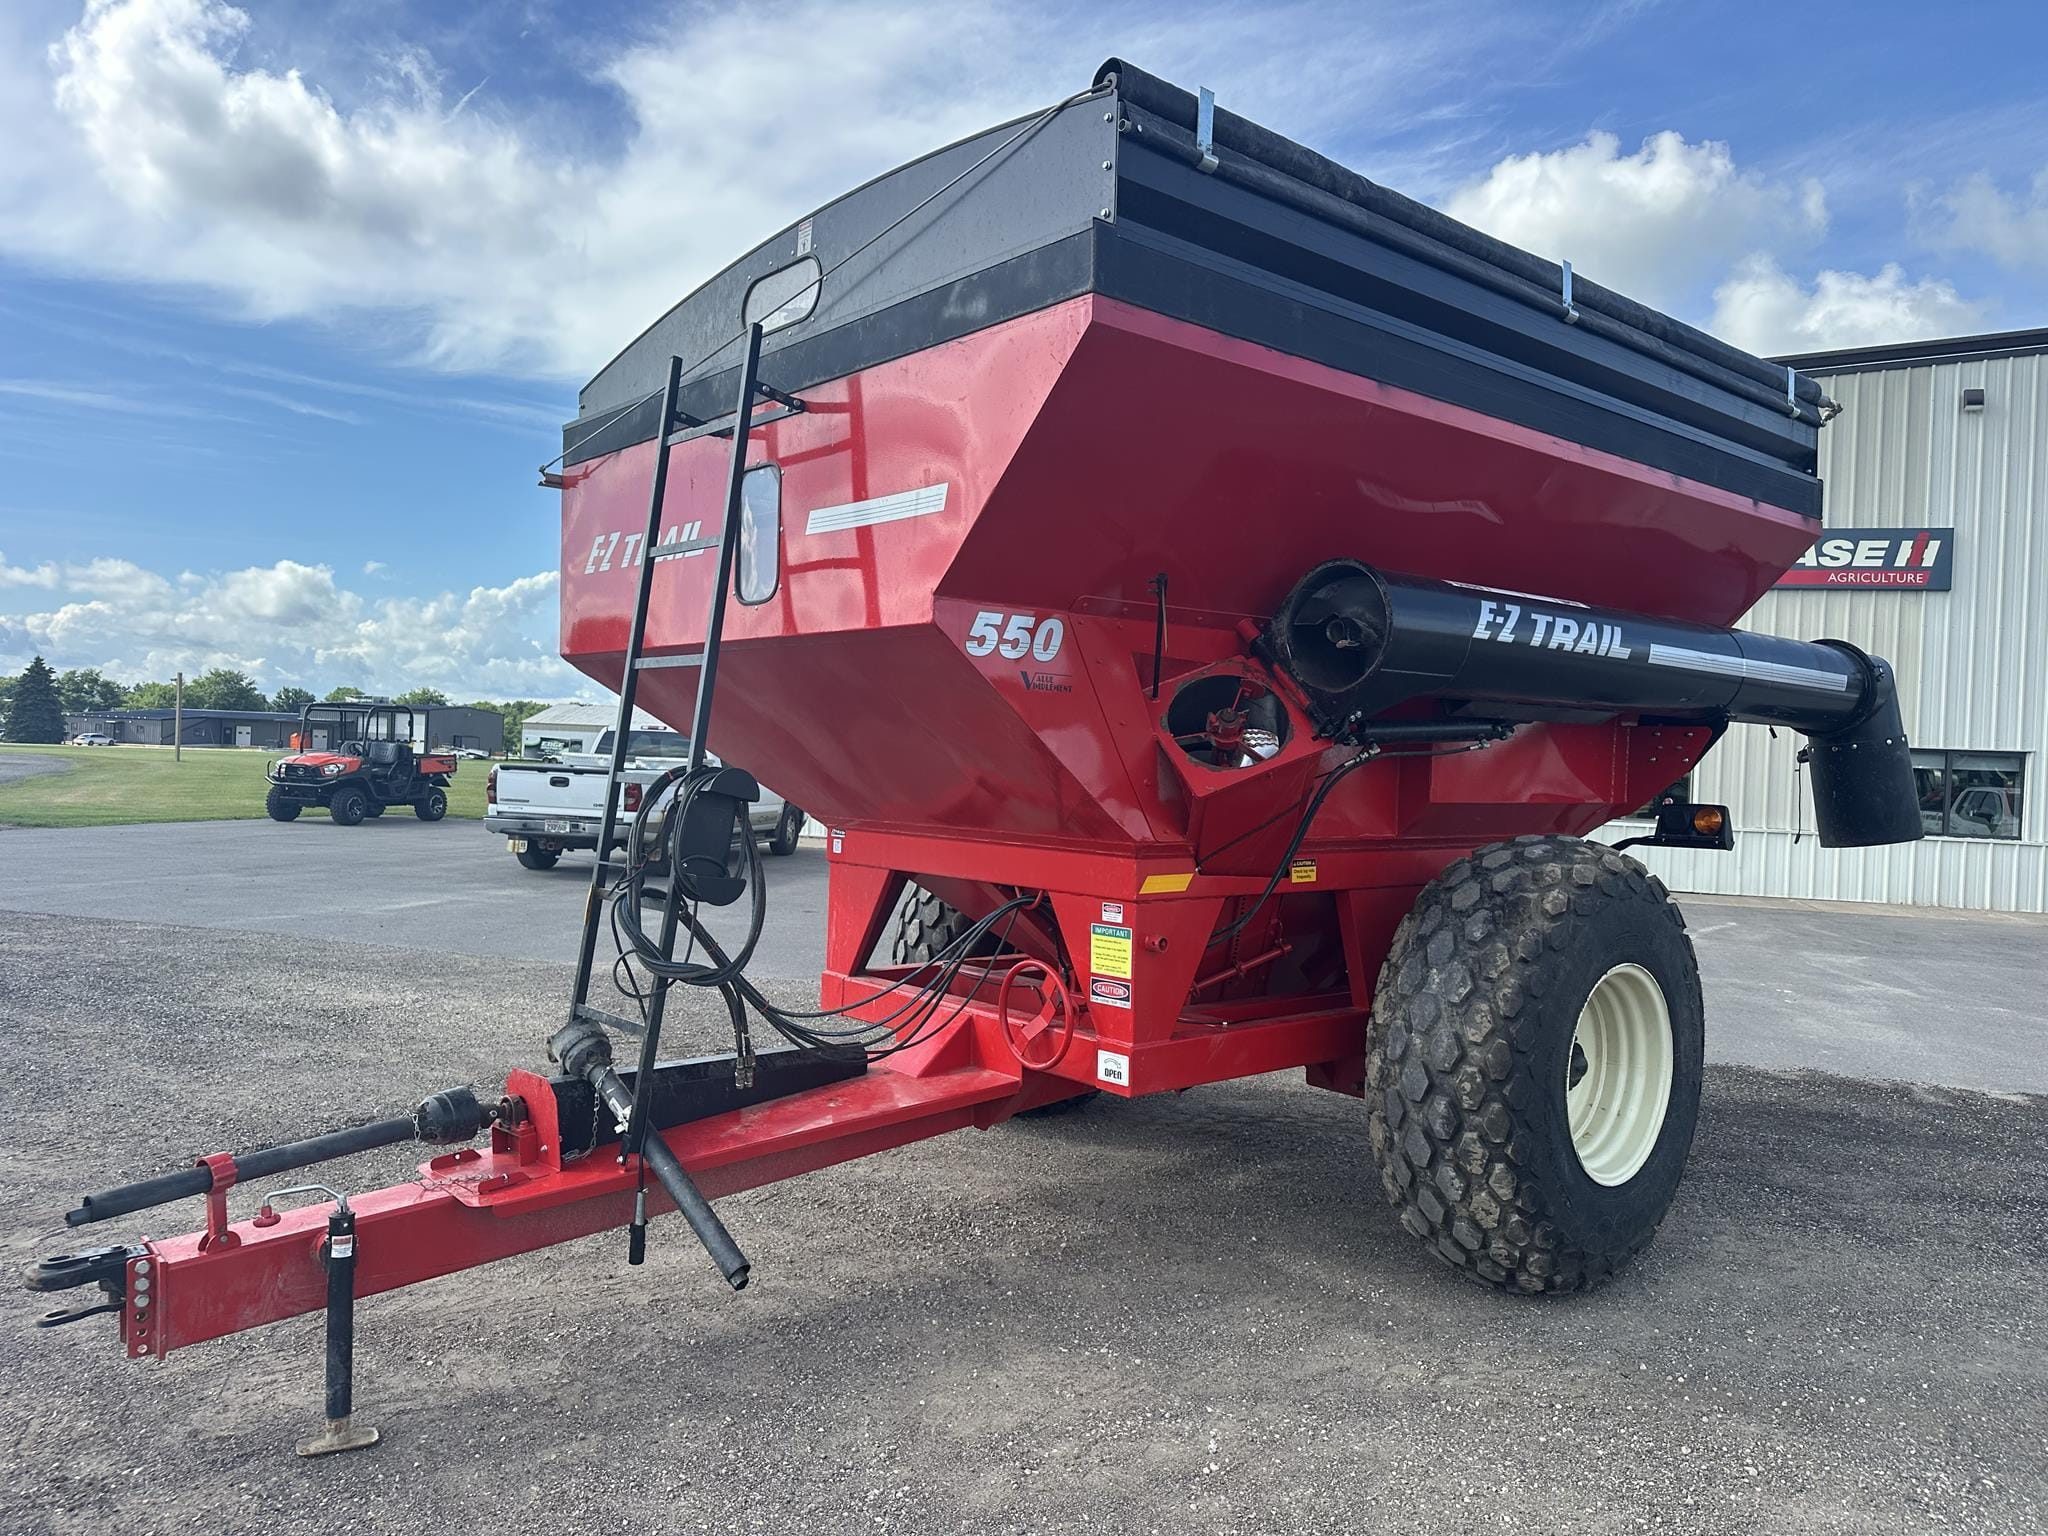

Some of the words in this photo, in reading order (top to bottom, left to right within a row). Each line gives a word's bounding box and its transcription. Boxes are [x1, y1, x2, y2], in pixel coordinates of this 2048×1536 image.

[1826, 571, 1924, 584] AGRICULTURE
[964, 610, 1065, 663] 550
[1528, 612, 1633, 660] TRAIL
[1094, 927, 1129, 938] IMPORTANT
[1097, 984, 1125, 996] CAUTION
[1104, 1067, 1122, 1081] OPEN
